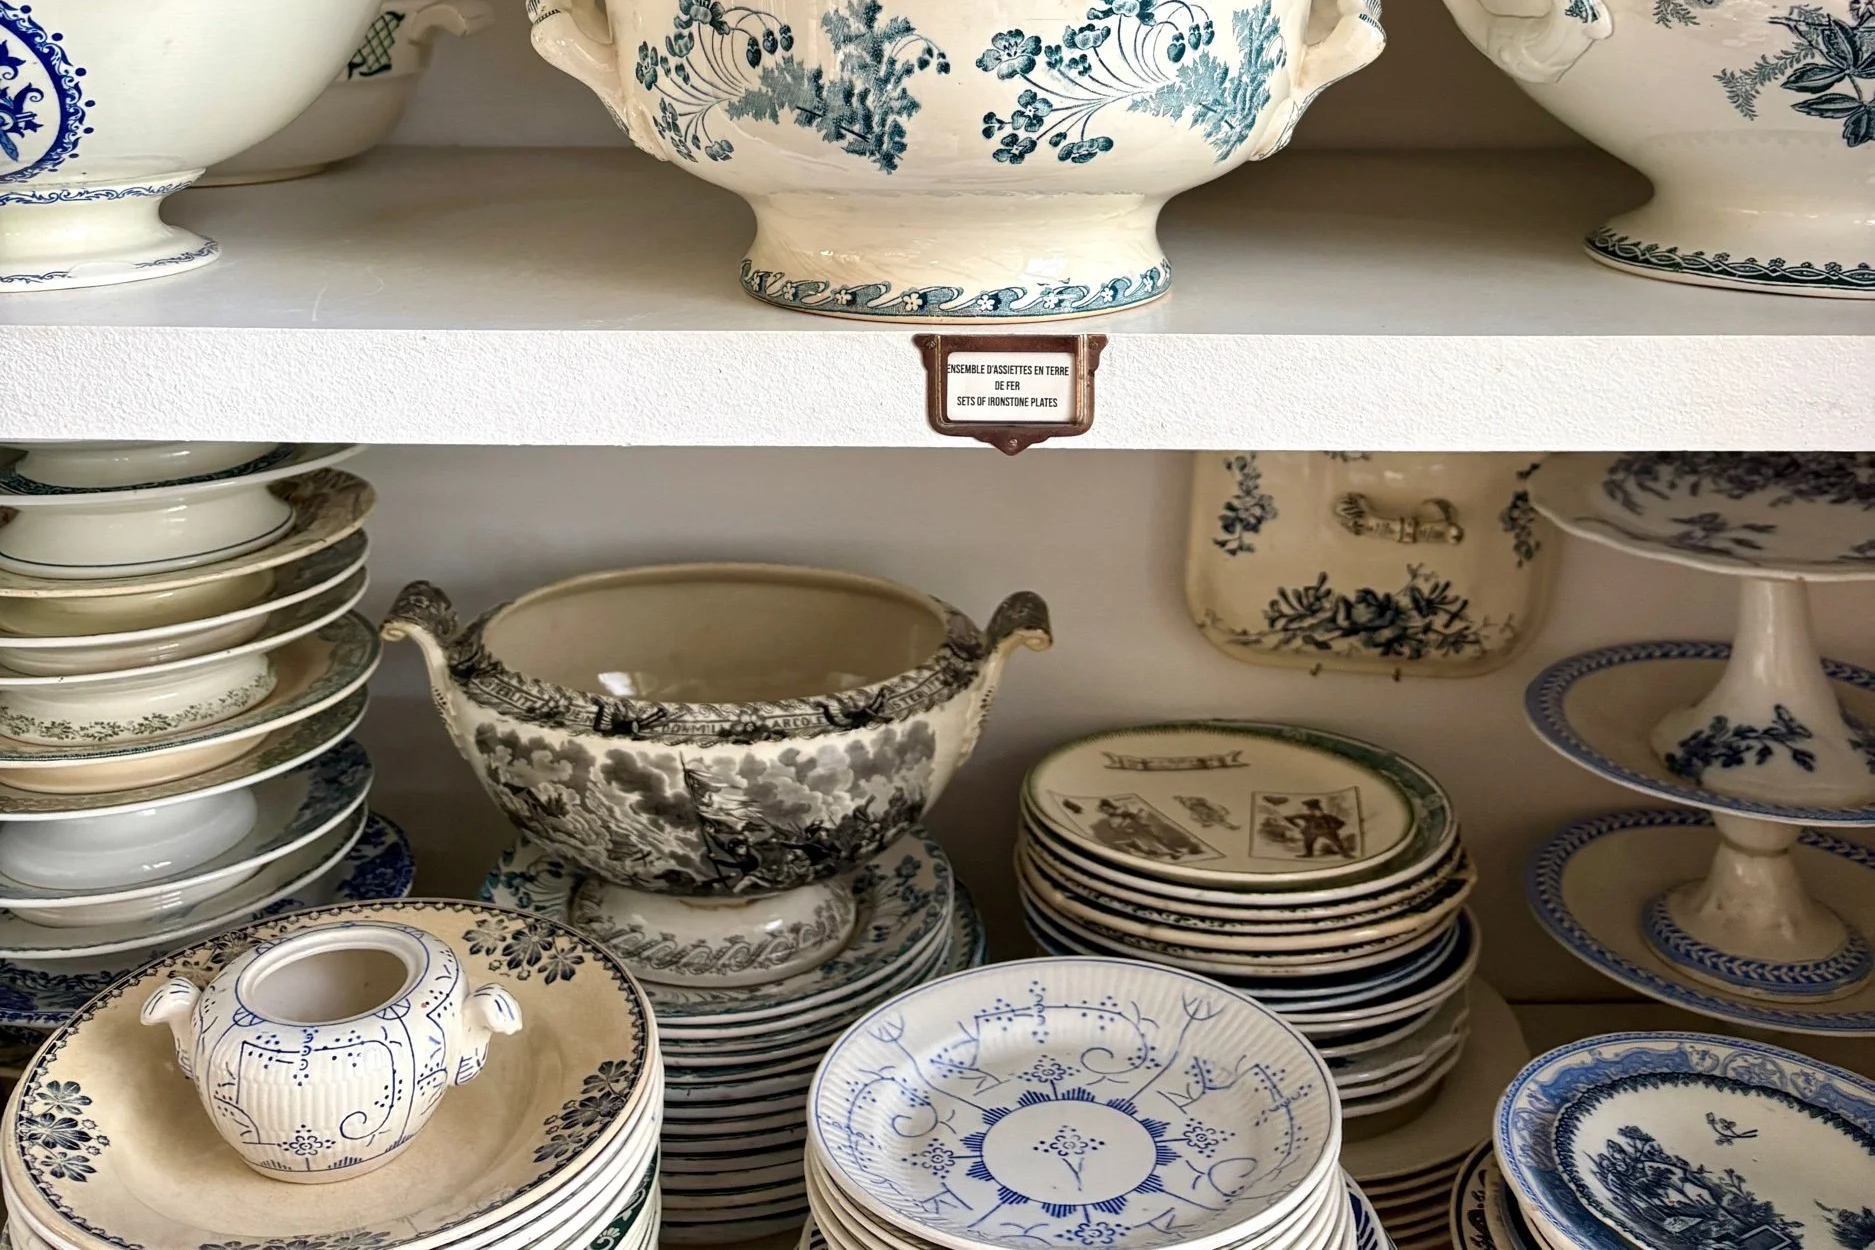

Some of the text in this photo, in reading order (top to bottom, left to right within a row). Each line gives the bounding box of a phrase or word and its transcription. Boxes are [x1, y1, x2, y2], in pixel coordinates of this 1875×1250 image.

[947, 364, 1069, 376] ENSEMBLE D'ASSIETTES EN TERRE
[995, 381, 1020, 391] DE FER
[957, 396, 1057, 408] SETS OF IRONSTONE PLATES
